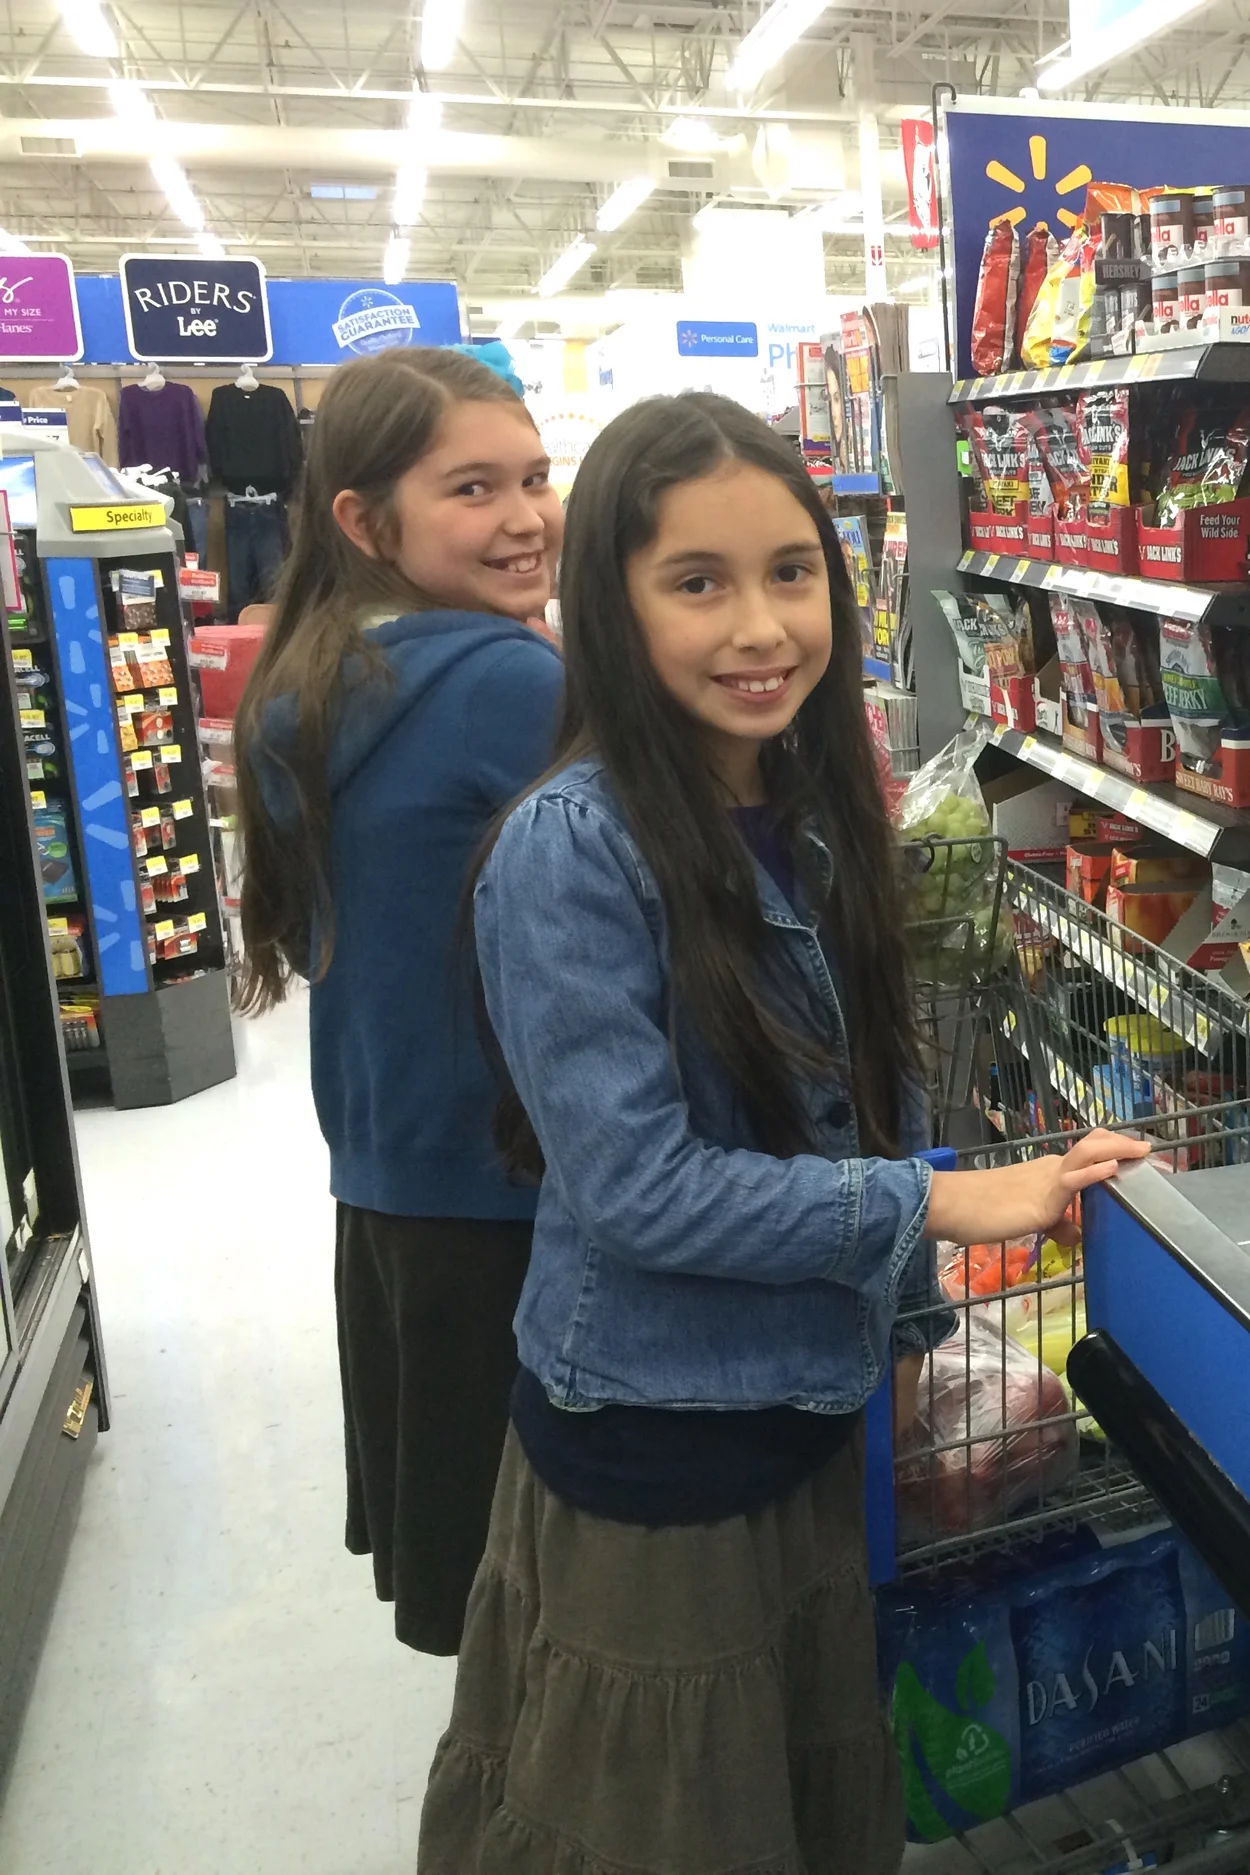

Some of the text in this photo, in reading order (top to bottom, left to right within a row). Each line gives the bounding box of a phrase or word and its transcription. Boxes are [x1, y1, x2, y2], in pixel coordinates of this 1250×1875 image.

[133, 280, 254, 315] RIDERS
[4, 308, 42, 317] MY SIZE
[190, 307, 202, 316] BY
[176, 316, 217, 337] Lee
[337, 308, 411, 333] SATISFACTION
[340, 316, 415, 341] GUARANTEE
[767, 323, 815, 334] Walmart
[701, 333, 754, 344] Personal Care
[27, 415, 48, 426] Price
[106, 510, 153, 525] Specialty
[1200, 514, 1241, 527] Feed Your
[1200, 526, 1239, 539] Wild Side
[1147, 545, 1182, 563] JACK LINK'S
[1175, 771, 1195, 789] SWEET
[1213, 783, 1234, 802] RAY'S
[1026, 1628, 1178, 1727] DASANI
[1068, 1716, 1141, 1753] PURIFIED WATER
